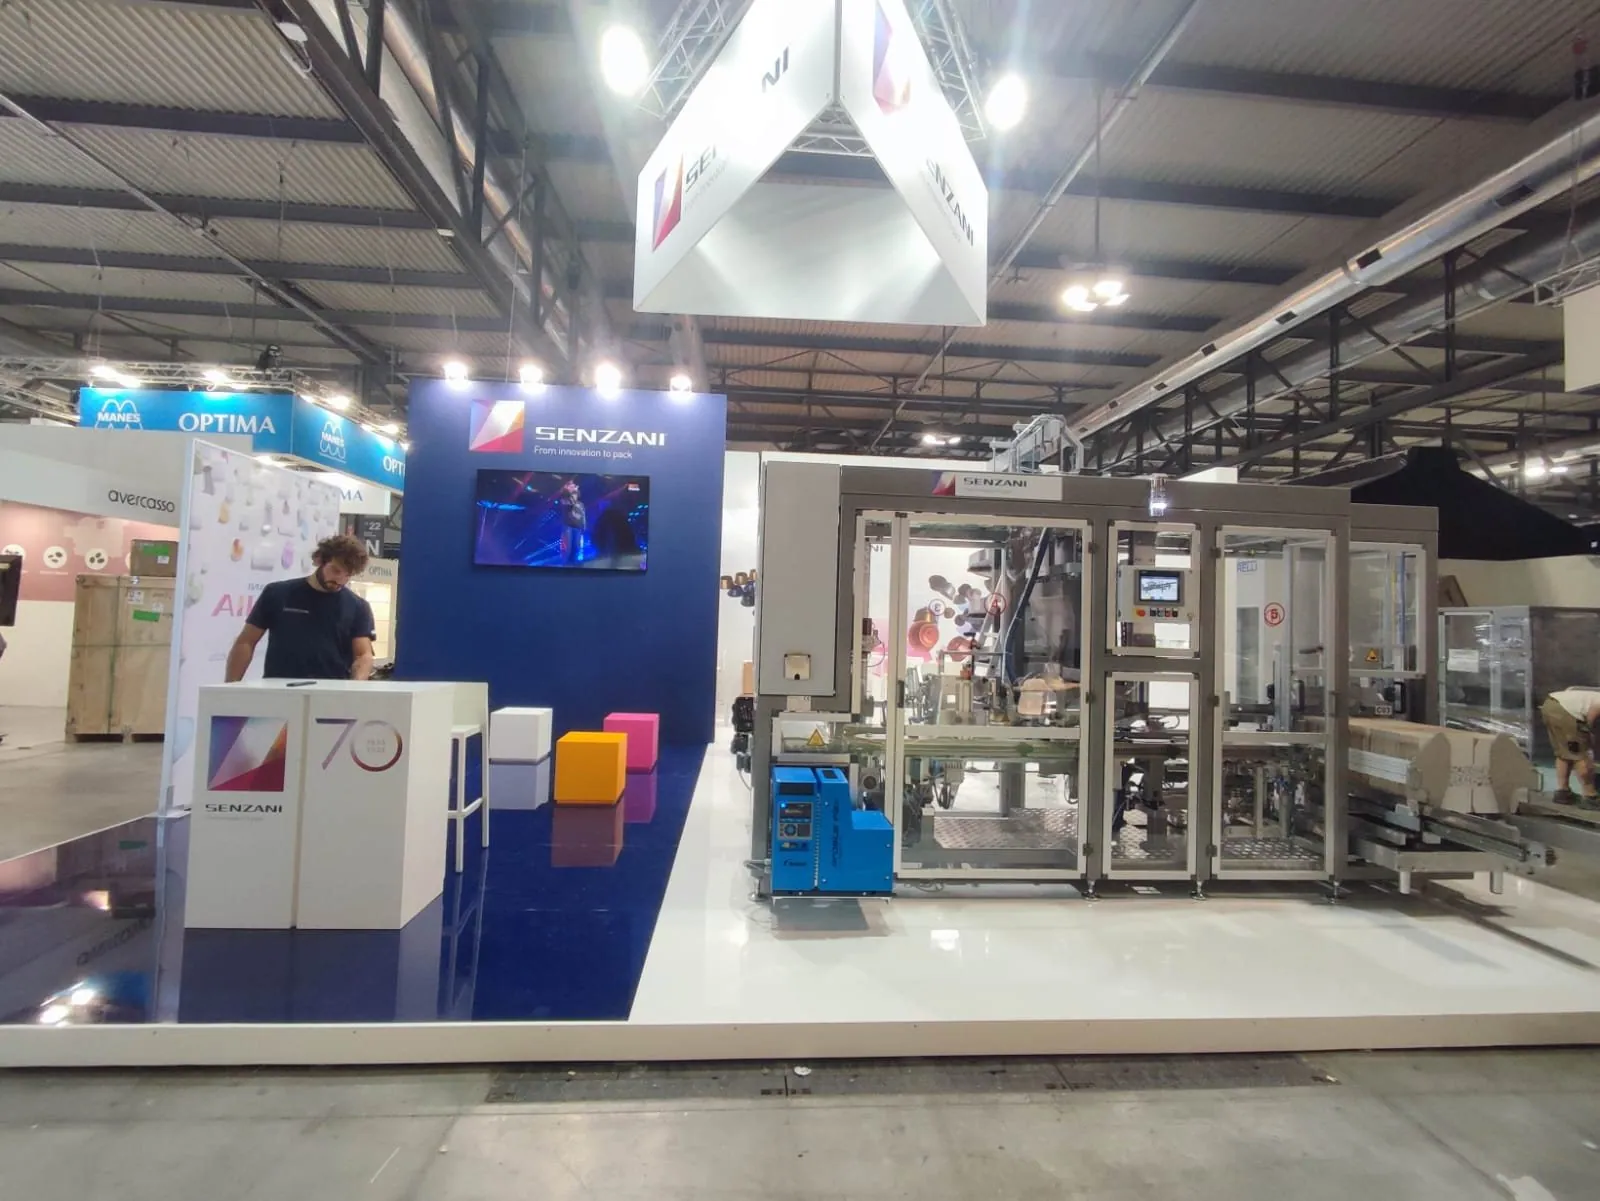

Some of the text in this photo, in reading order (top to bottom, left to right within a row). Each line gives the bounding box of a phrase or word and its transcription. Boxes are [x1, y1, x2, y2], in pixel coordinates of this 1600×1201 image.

[97, 412, 141, 424] MANES
[178, 413, 276, 434] OPTIMA
[535, 426, 666, 446] SENZANI
[534, 445, 633, 460] From innovation to pack
[963, 477, 1028, 488] SENZANI
[108, 489, 176, 513] avercasso
[315, 717, 403, 772] 70
[205, 803, 283, 813] SENZANI
